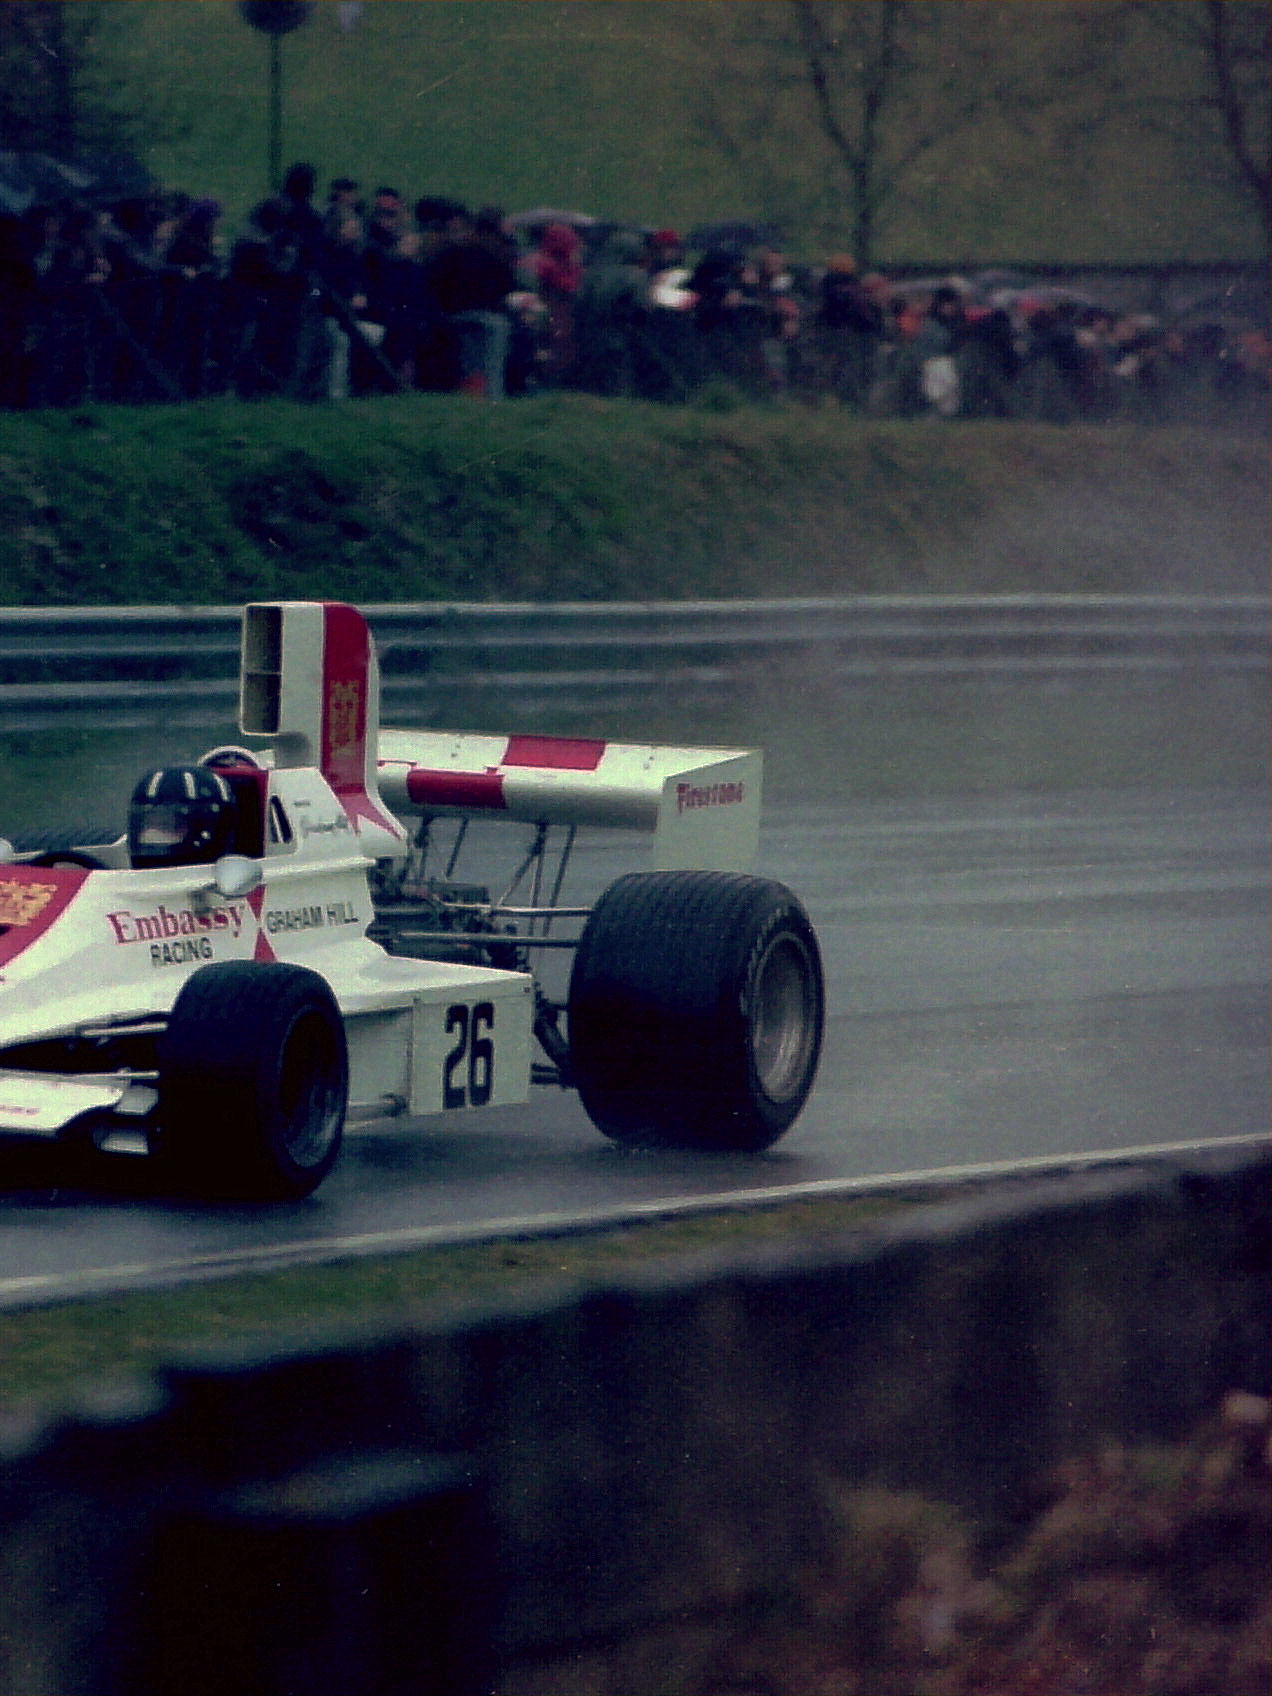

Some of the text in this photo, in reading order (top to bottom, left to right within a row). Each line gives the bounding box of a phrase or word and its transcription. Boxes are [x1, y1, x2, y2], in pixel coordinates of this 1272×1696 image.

[107, 904, 245, 944] Embassy
[267, 901, 360, 934] GRAHAM HILL
[150, 936, 214, 967] RACING
[442, 1002, 495, 1109] 26
